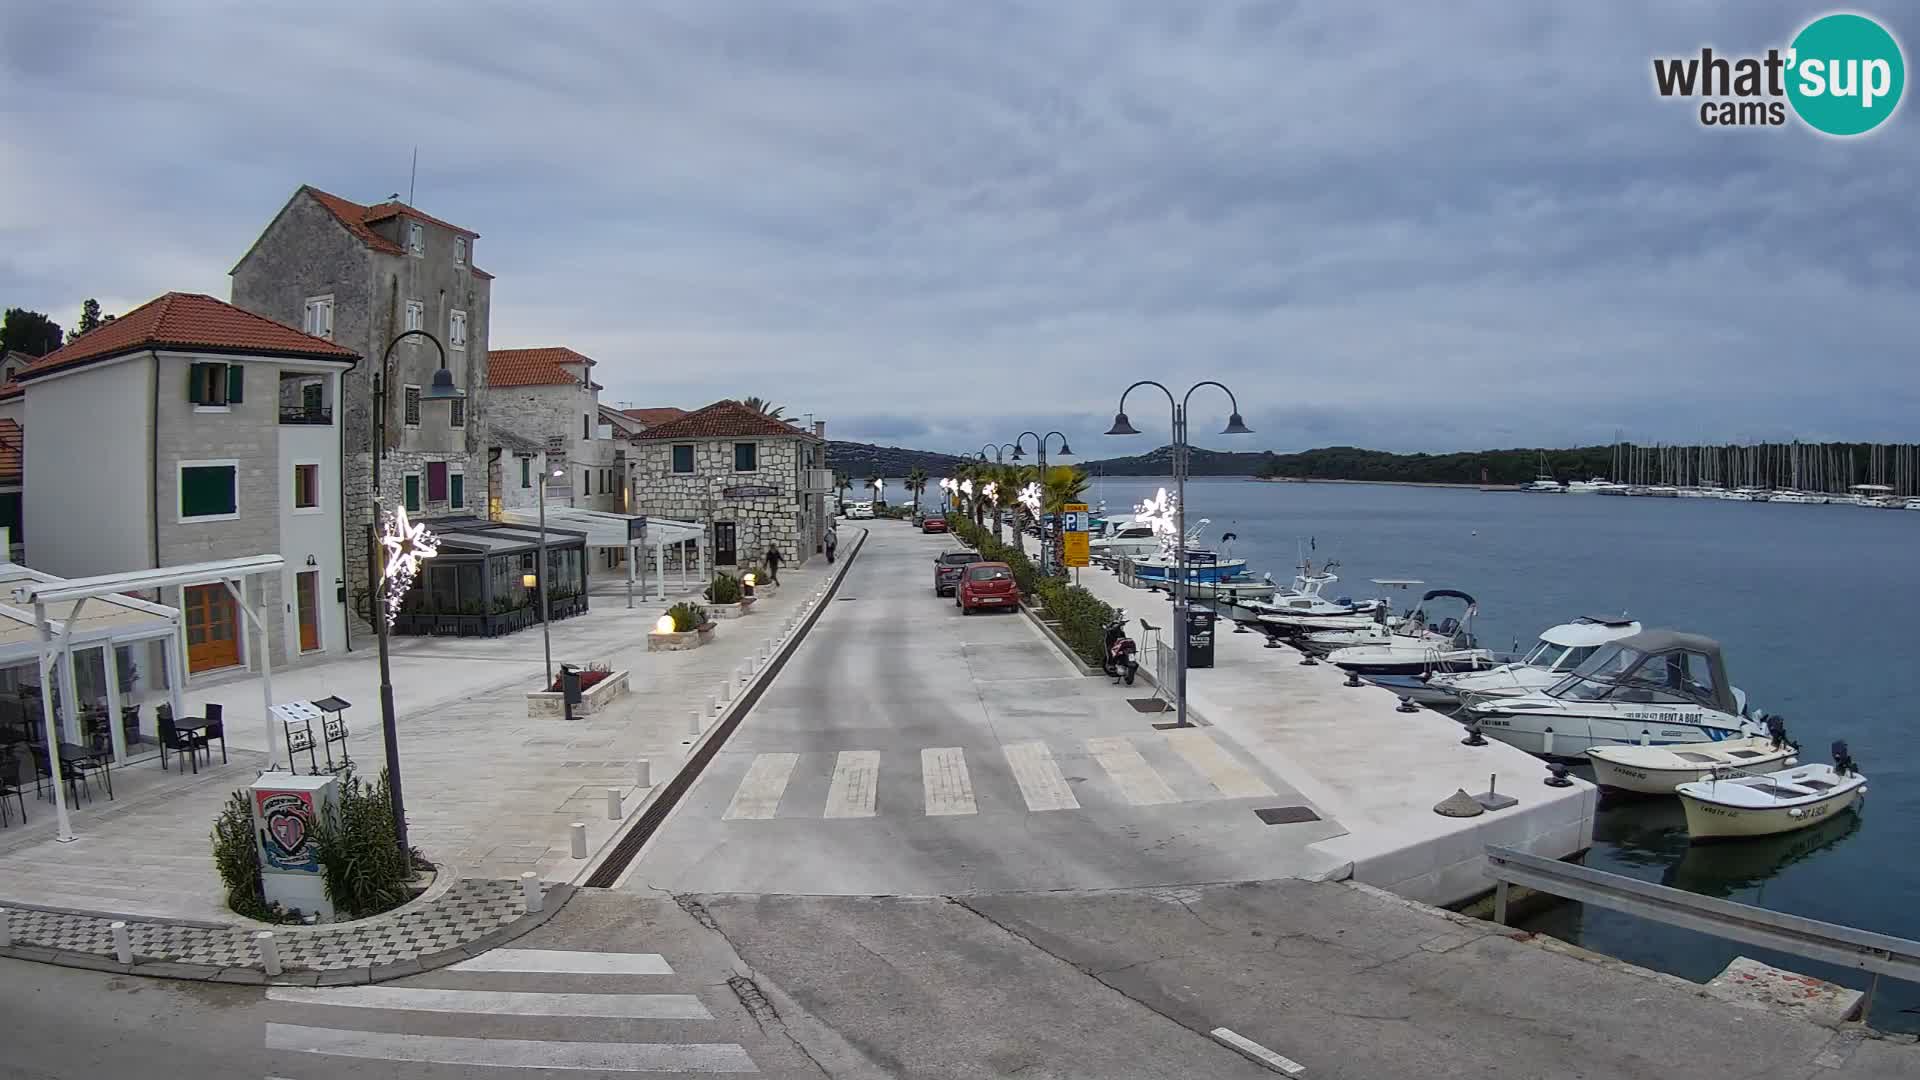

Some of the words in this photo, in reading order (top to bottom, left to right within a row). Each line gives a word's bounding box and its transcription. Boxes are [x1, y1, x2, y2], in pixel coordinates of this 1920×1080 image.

[1659, 712, 1678, 721] RENT
[1679, 712, 1684, 722] A
[1685, 713, 1704, 724] BOAT
